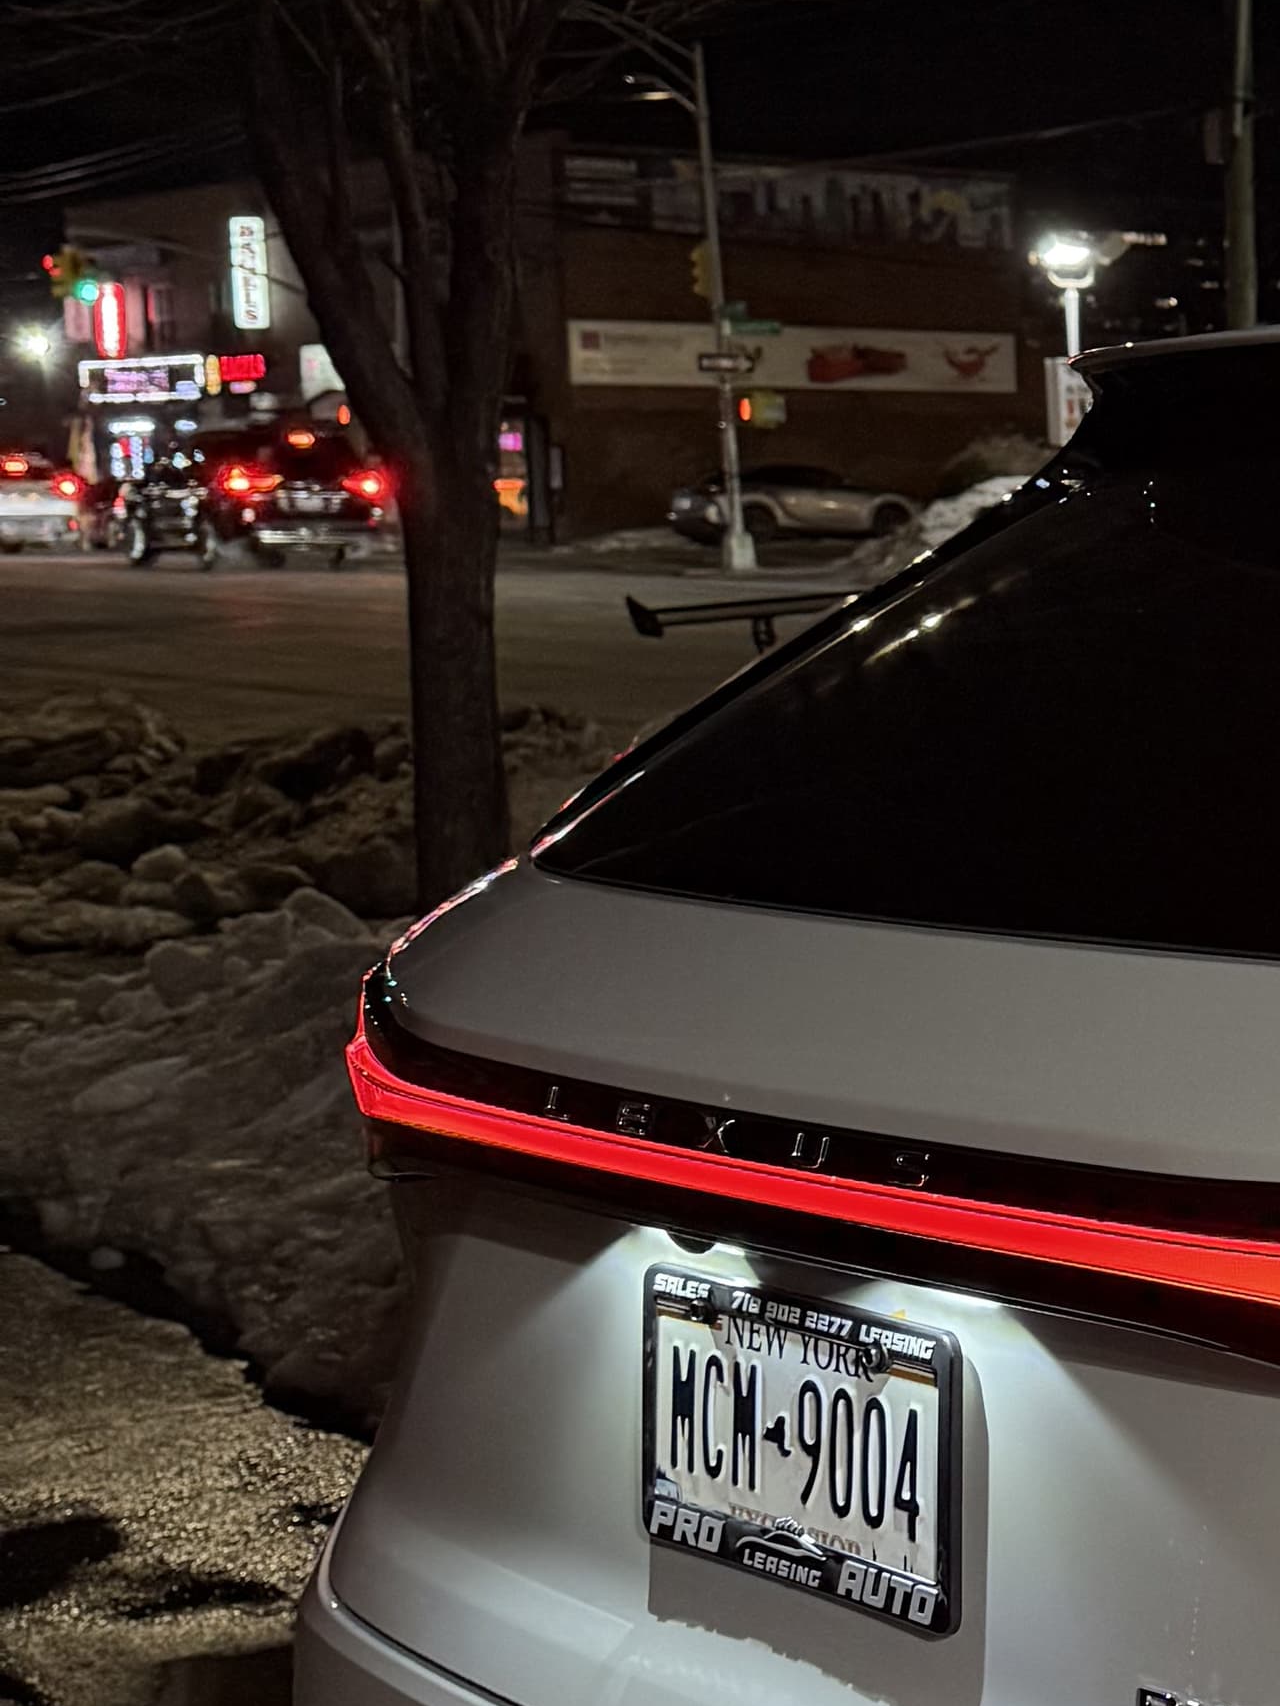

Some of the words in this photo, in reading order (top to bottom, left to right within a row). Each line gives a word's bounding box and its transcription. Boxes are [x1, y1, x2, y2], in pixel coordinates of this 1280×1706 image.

[545, 1086, 930, 1187] LEXUS
[653, 1273, 711, 1299] SALES
[731, 1290, 761, 1313] 718
[764, 1301, 801, 1324] 902
[805, 1310, 853, 1336] 2277
[859, 1324, 936, 1359] LEASING
[725, 1315, 788, 1359] NEW
[800, 1332, 873, 1382] YORK
[671, 1344, 759, 1492] MCM
[799, 1380, 920, 1542] 9004
[650, 1500, 726, 1553] PRO
[743, 1549, 822, 1588] LEASING
[837, 1560, 939, 1626] AUTO
